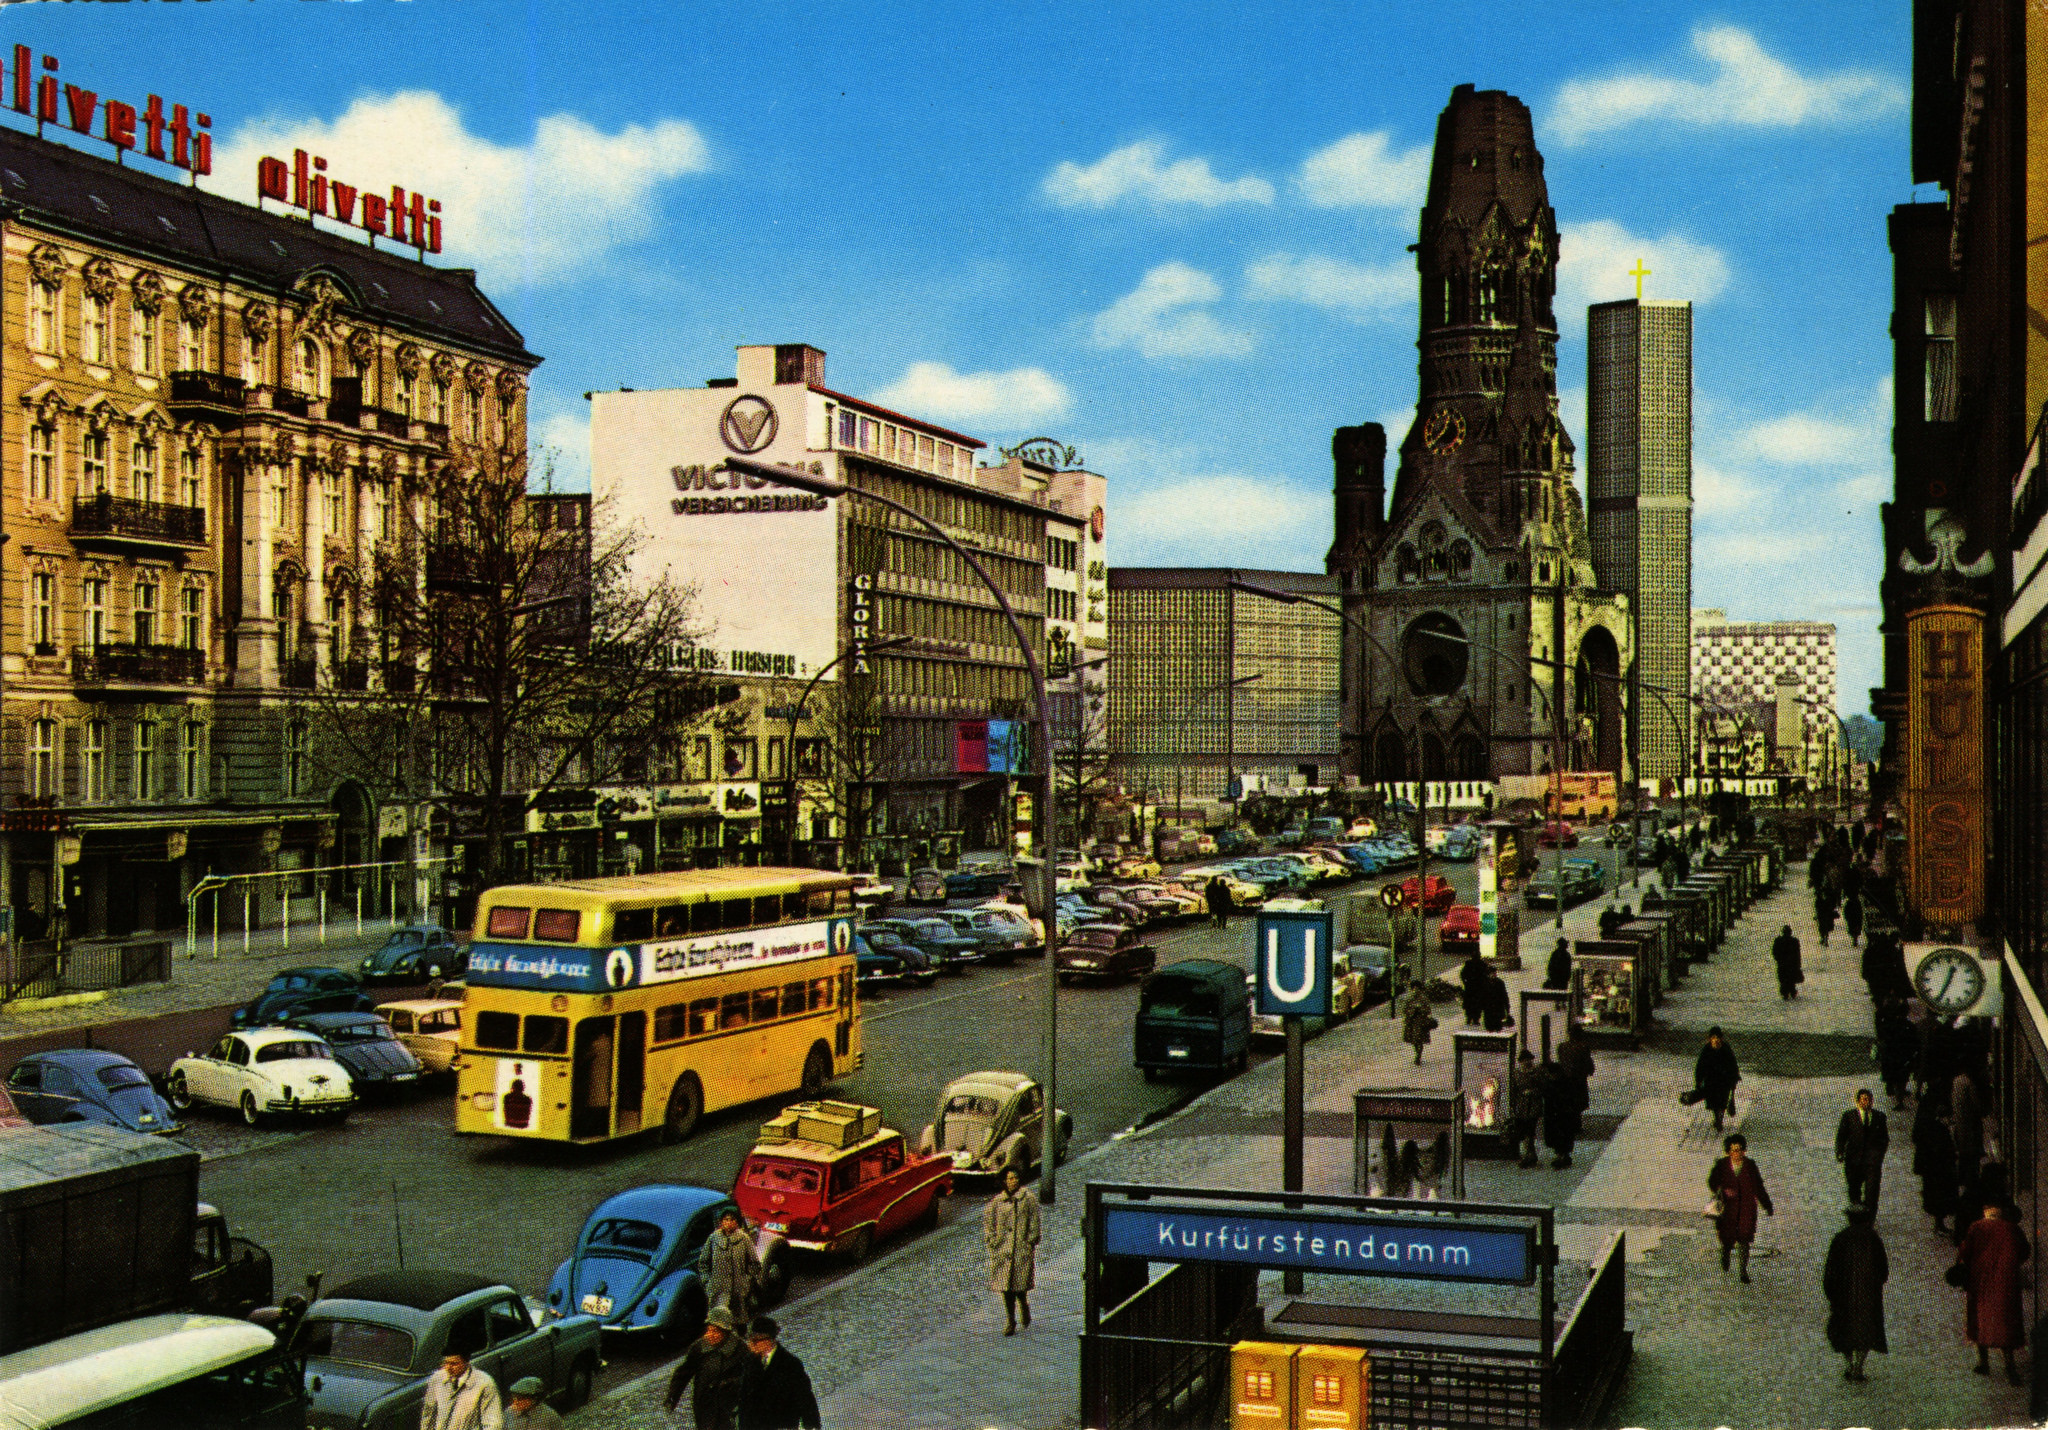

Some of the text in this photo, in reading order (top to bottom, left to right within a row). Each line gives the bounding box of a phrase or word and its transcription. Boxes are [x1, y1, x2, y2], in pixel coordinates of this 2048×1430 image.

[0, 43, 212, 177] livetti
[258, 148, 443, 255] olivetti
[670, 460, 826, 492] VICTOA
[670, 494, 829, 516] VERSICHERUNG
[852, 573, 872, 675] GLORIA
[1266, 928, 1317, 1004] U
[1157, 1221, 1471, 1266] Kurfürstendamm
